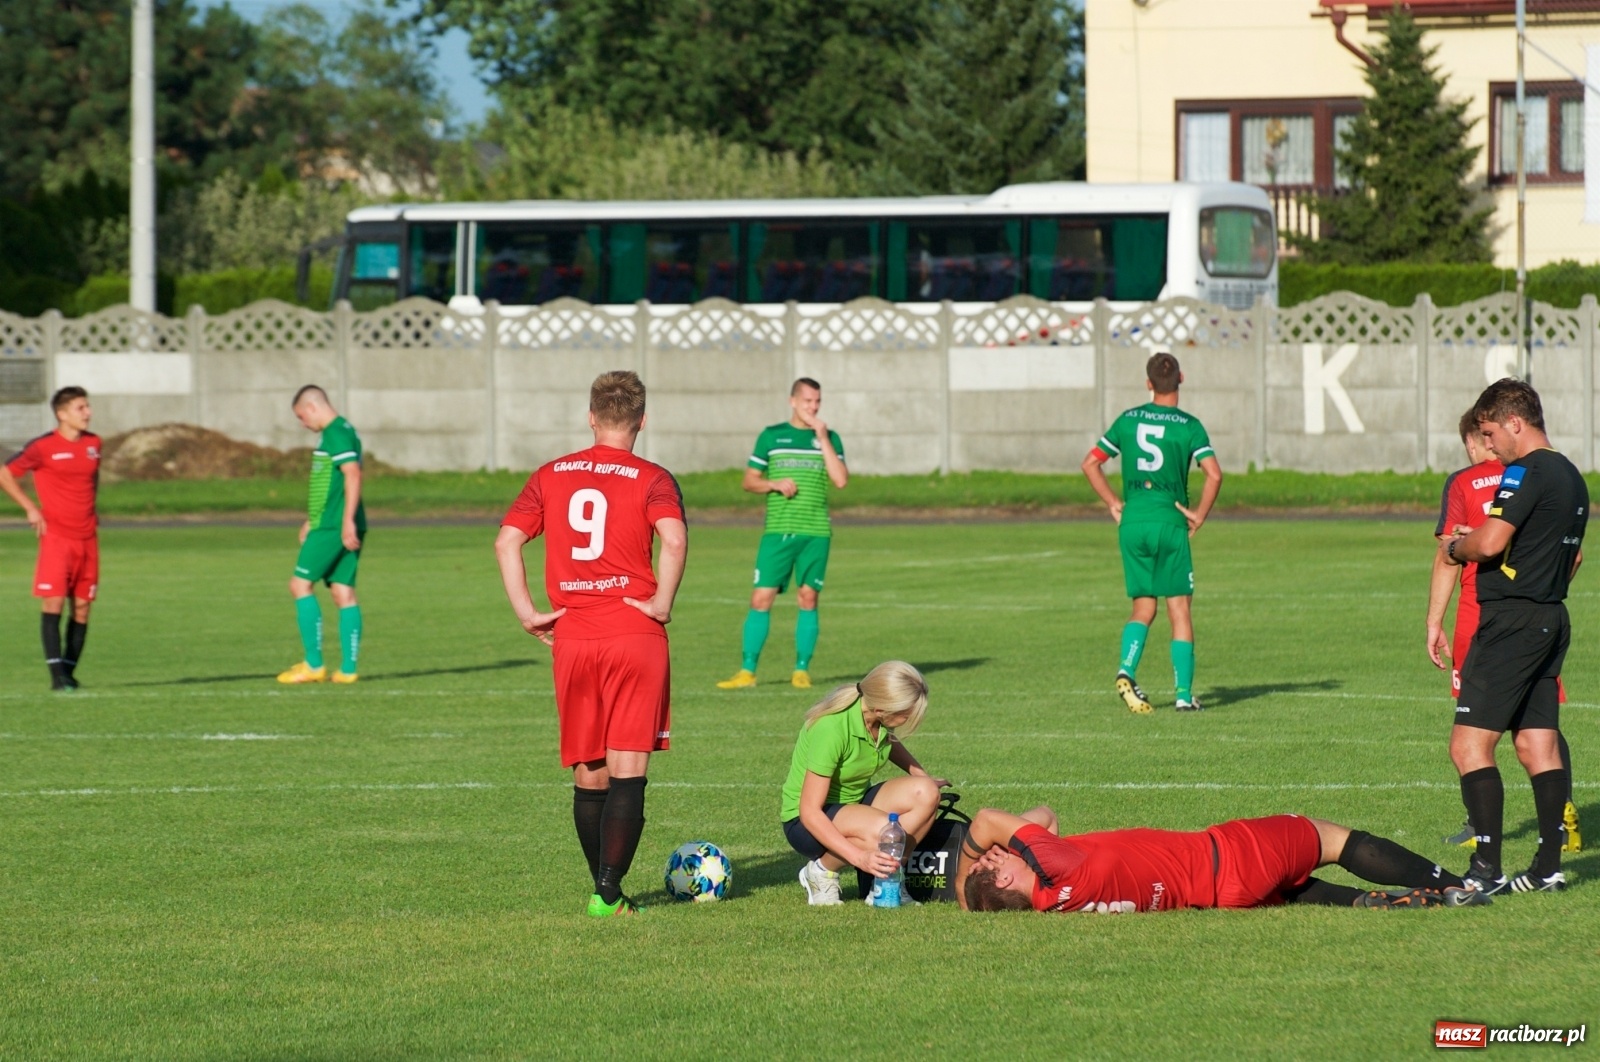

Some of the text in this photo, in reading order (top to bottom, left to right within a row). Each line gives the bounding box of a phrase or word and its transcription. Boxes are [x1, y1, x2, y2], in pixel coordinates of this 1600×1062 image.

[1303, 343, 1364, 433] K
[553, 460, 640, 479] GRANICA RUPTAWA
[1136, 422, 1165, 472] 5
[567, 487, 608, 561] 9
[560, 575, 630, 592] maxima-sport.pl
